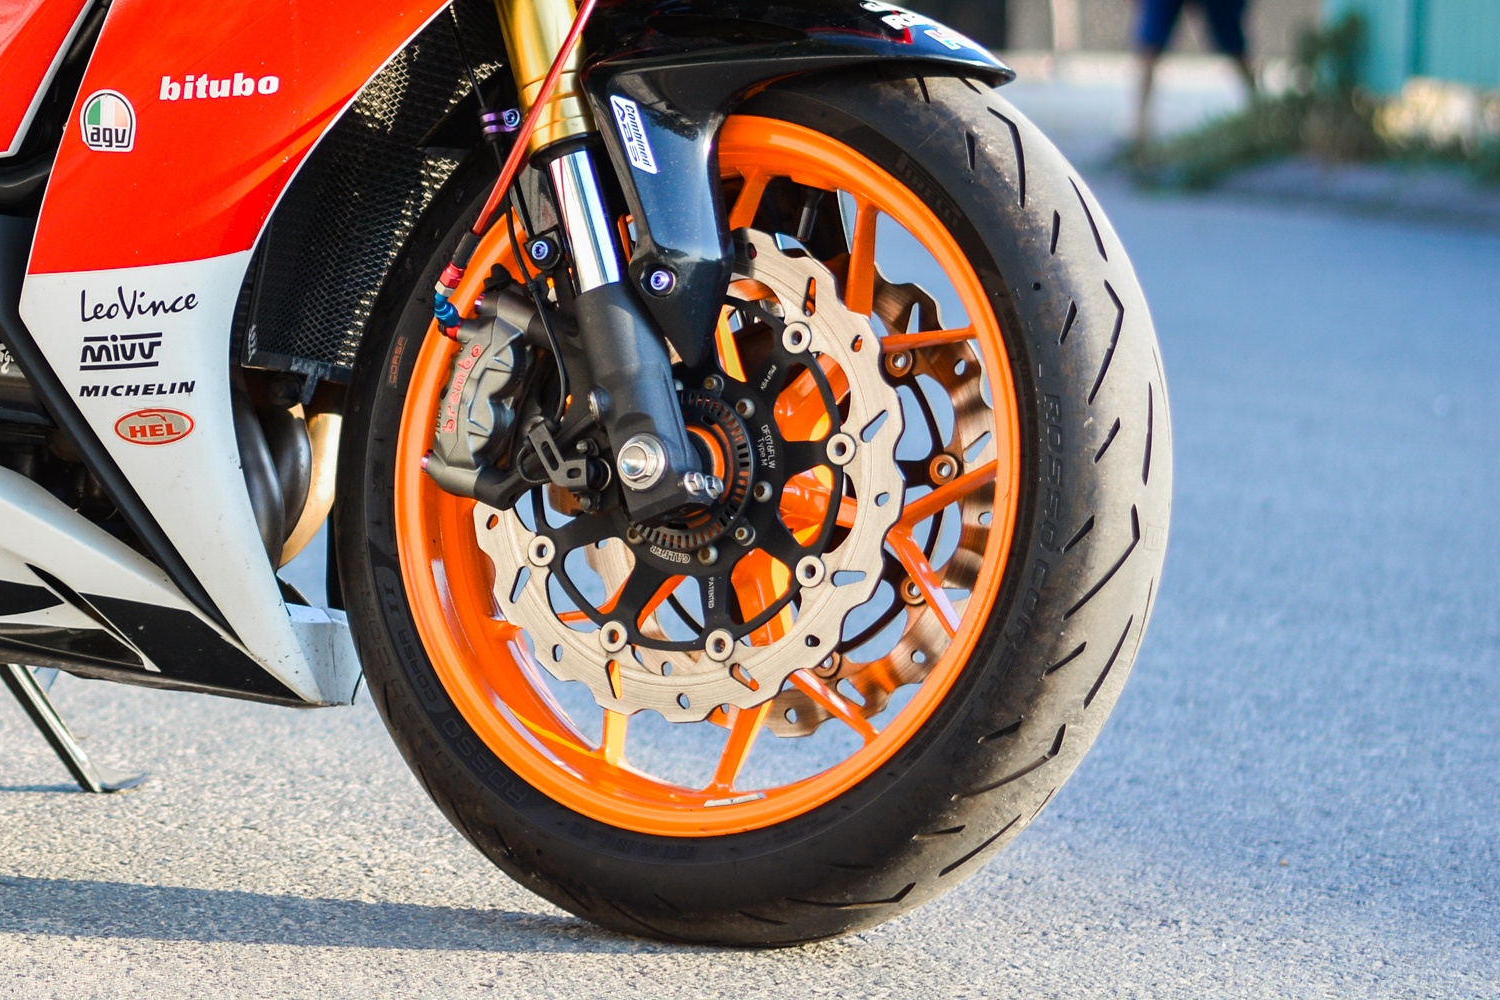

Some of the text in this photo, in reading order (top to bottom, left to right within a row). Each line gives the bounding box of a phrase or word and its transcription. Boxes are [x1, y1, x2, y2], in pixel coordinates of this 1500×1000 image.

[159, 72, 279, 101] bitubo
[90, 127, 127, 148] agv
[625, 104, 652, 168] Combined
[80, 285, 199, 322] LeoVince
[79, 380, 196, 397] MICHELIN
[442, 344, 482, 433] brembo
[129, 423, 181, 438] HEL
